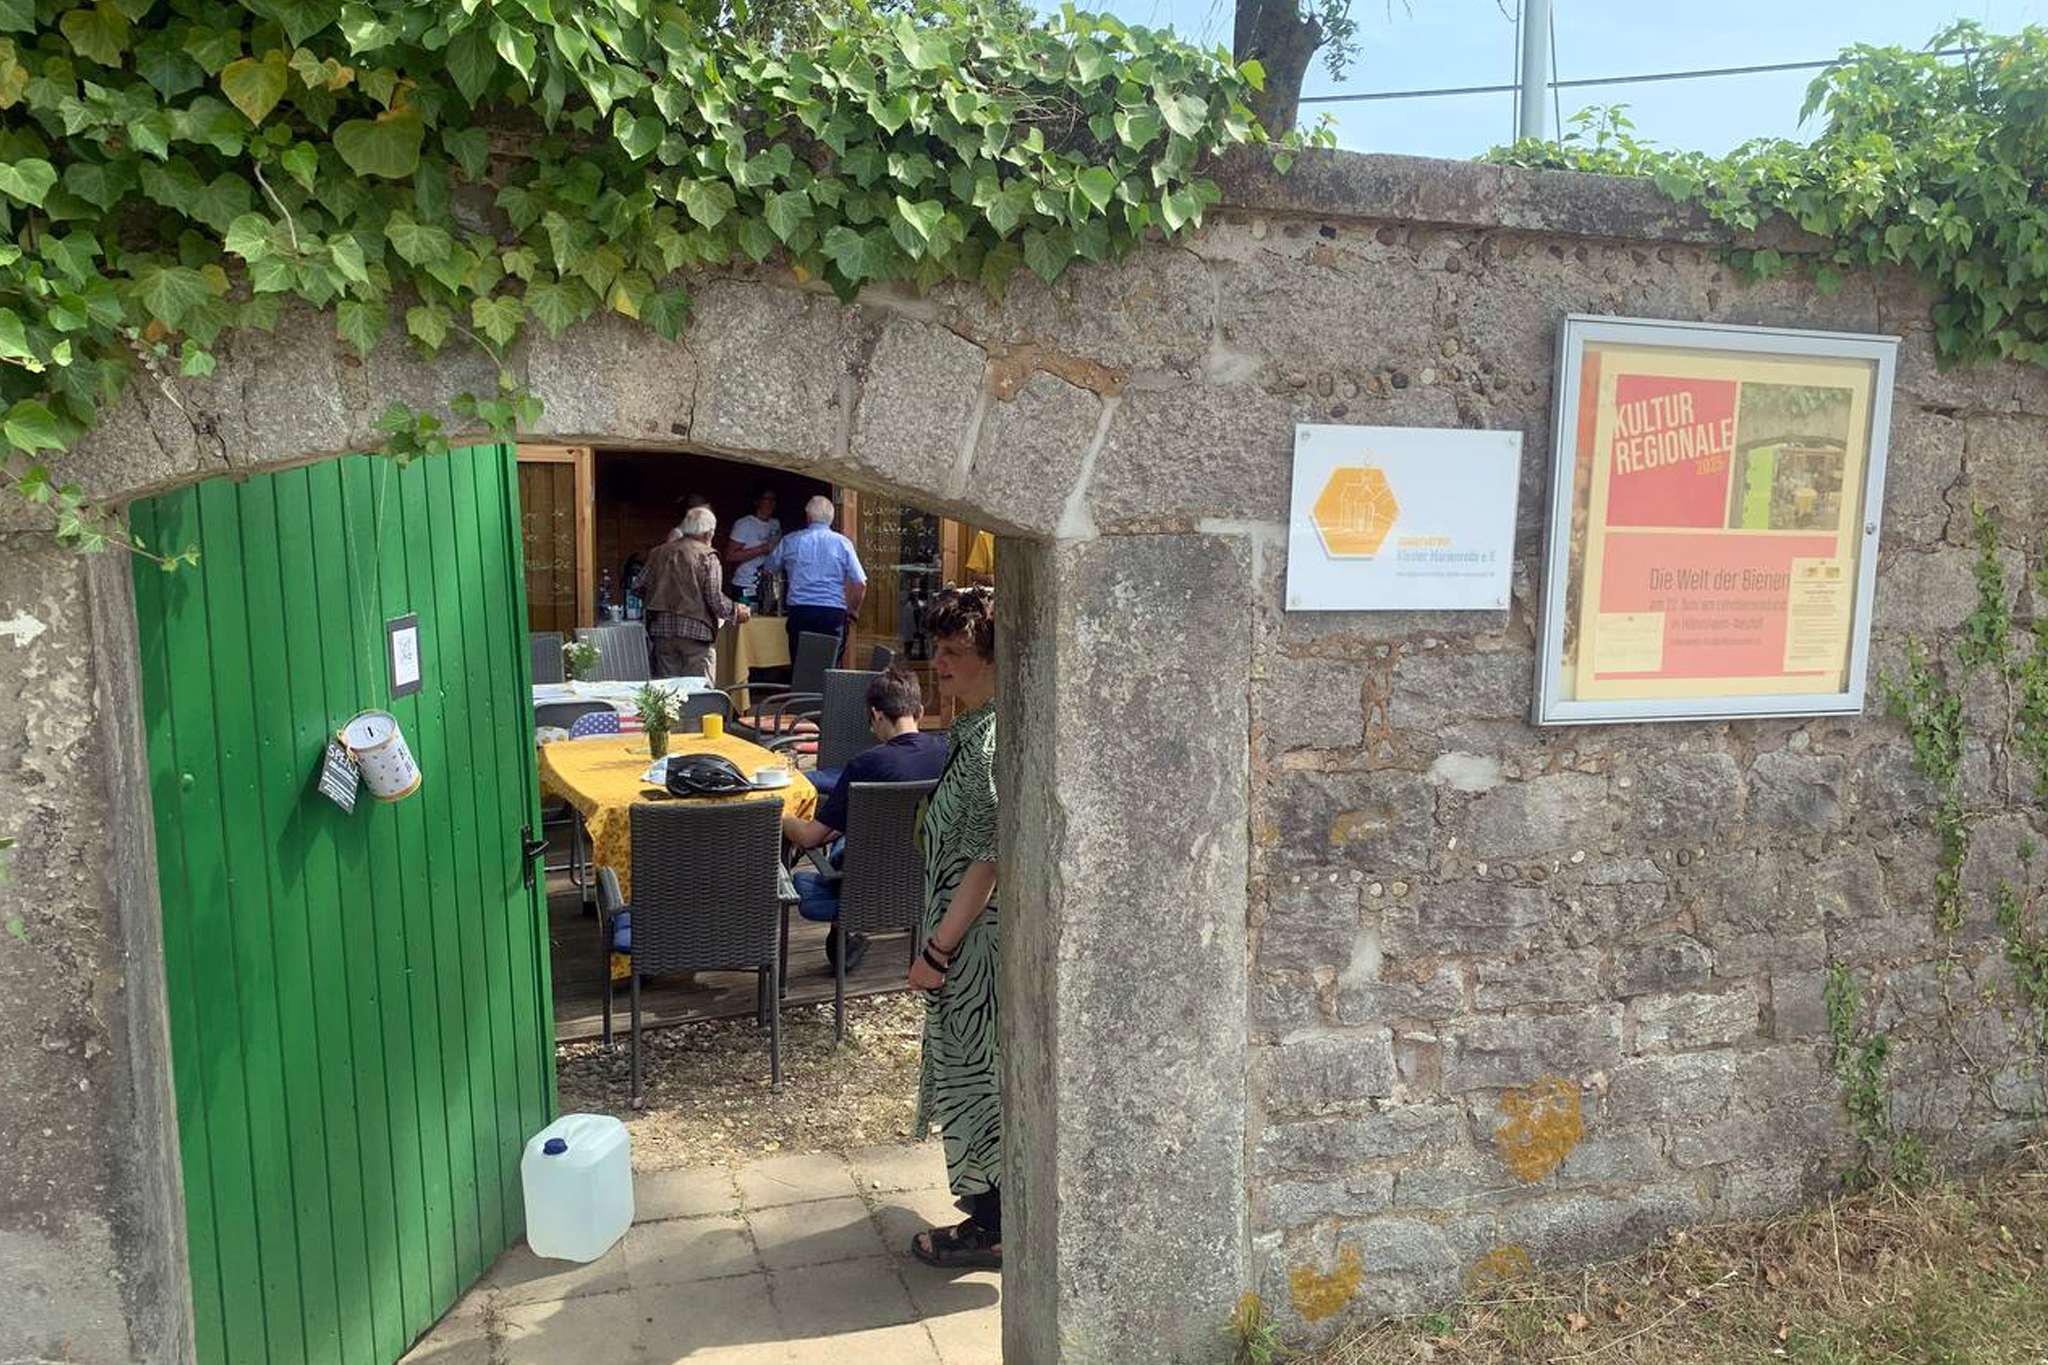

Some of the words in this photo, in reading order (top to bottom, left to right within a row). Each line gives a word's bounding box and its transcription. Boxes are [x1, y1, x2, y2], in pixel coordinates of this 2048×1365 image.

[1614, 391, 1694, 439] KULTUR
[1615, 417, 1733, 475] REGIONALE
[1650, 567, 1673, 591] Die
[1676, 567, 1708, 591] Welt
[1713, 567, 1738, 591] der
[1742, 568, 1790, 591] Bienen
